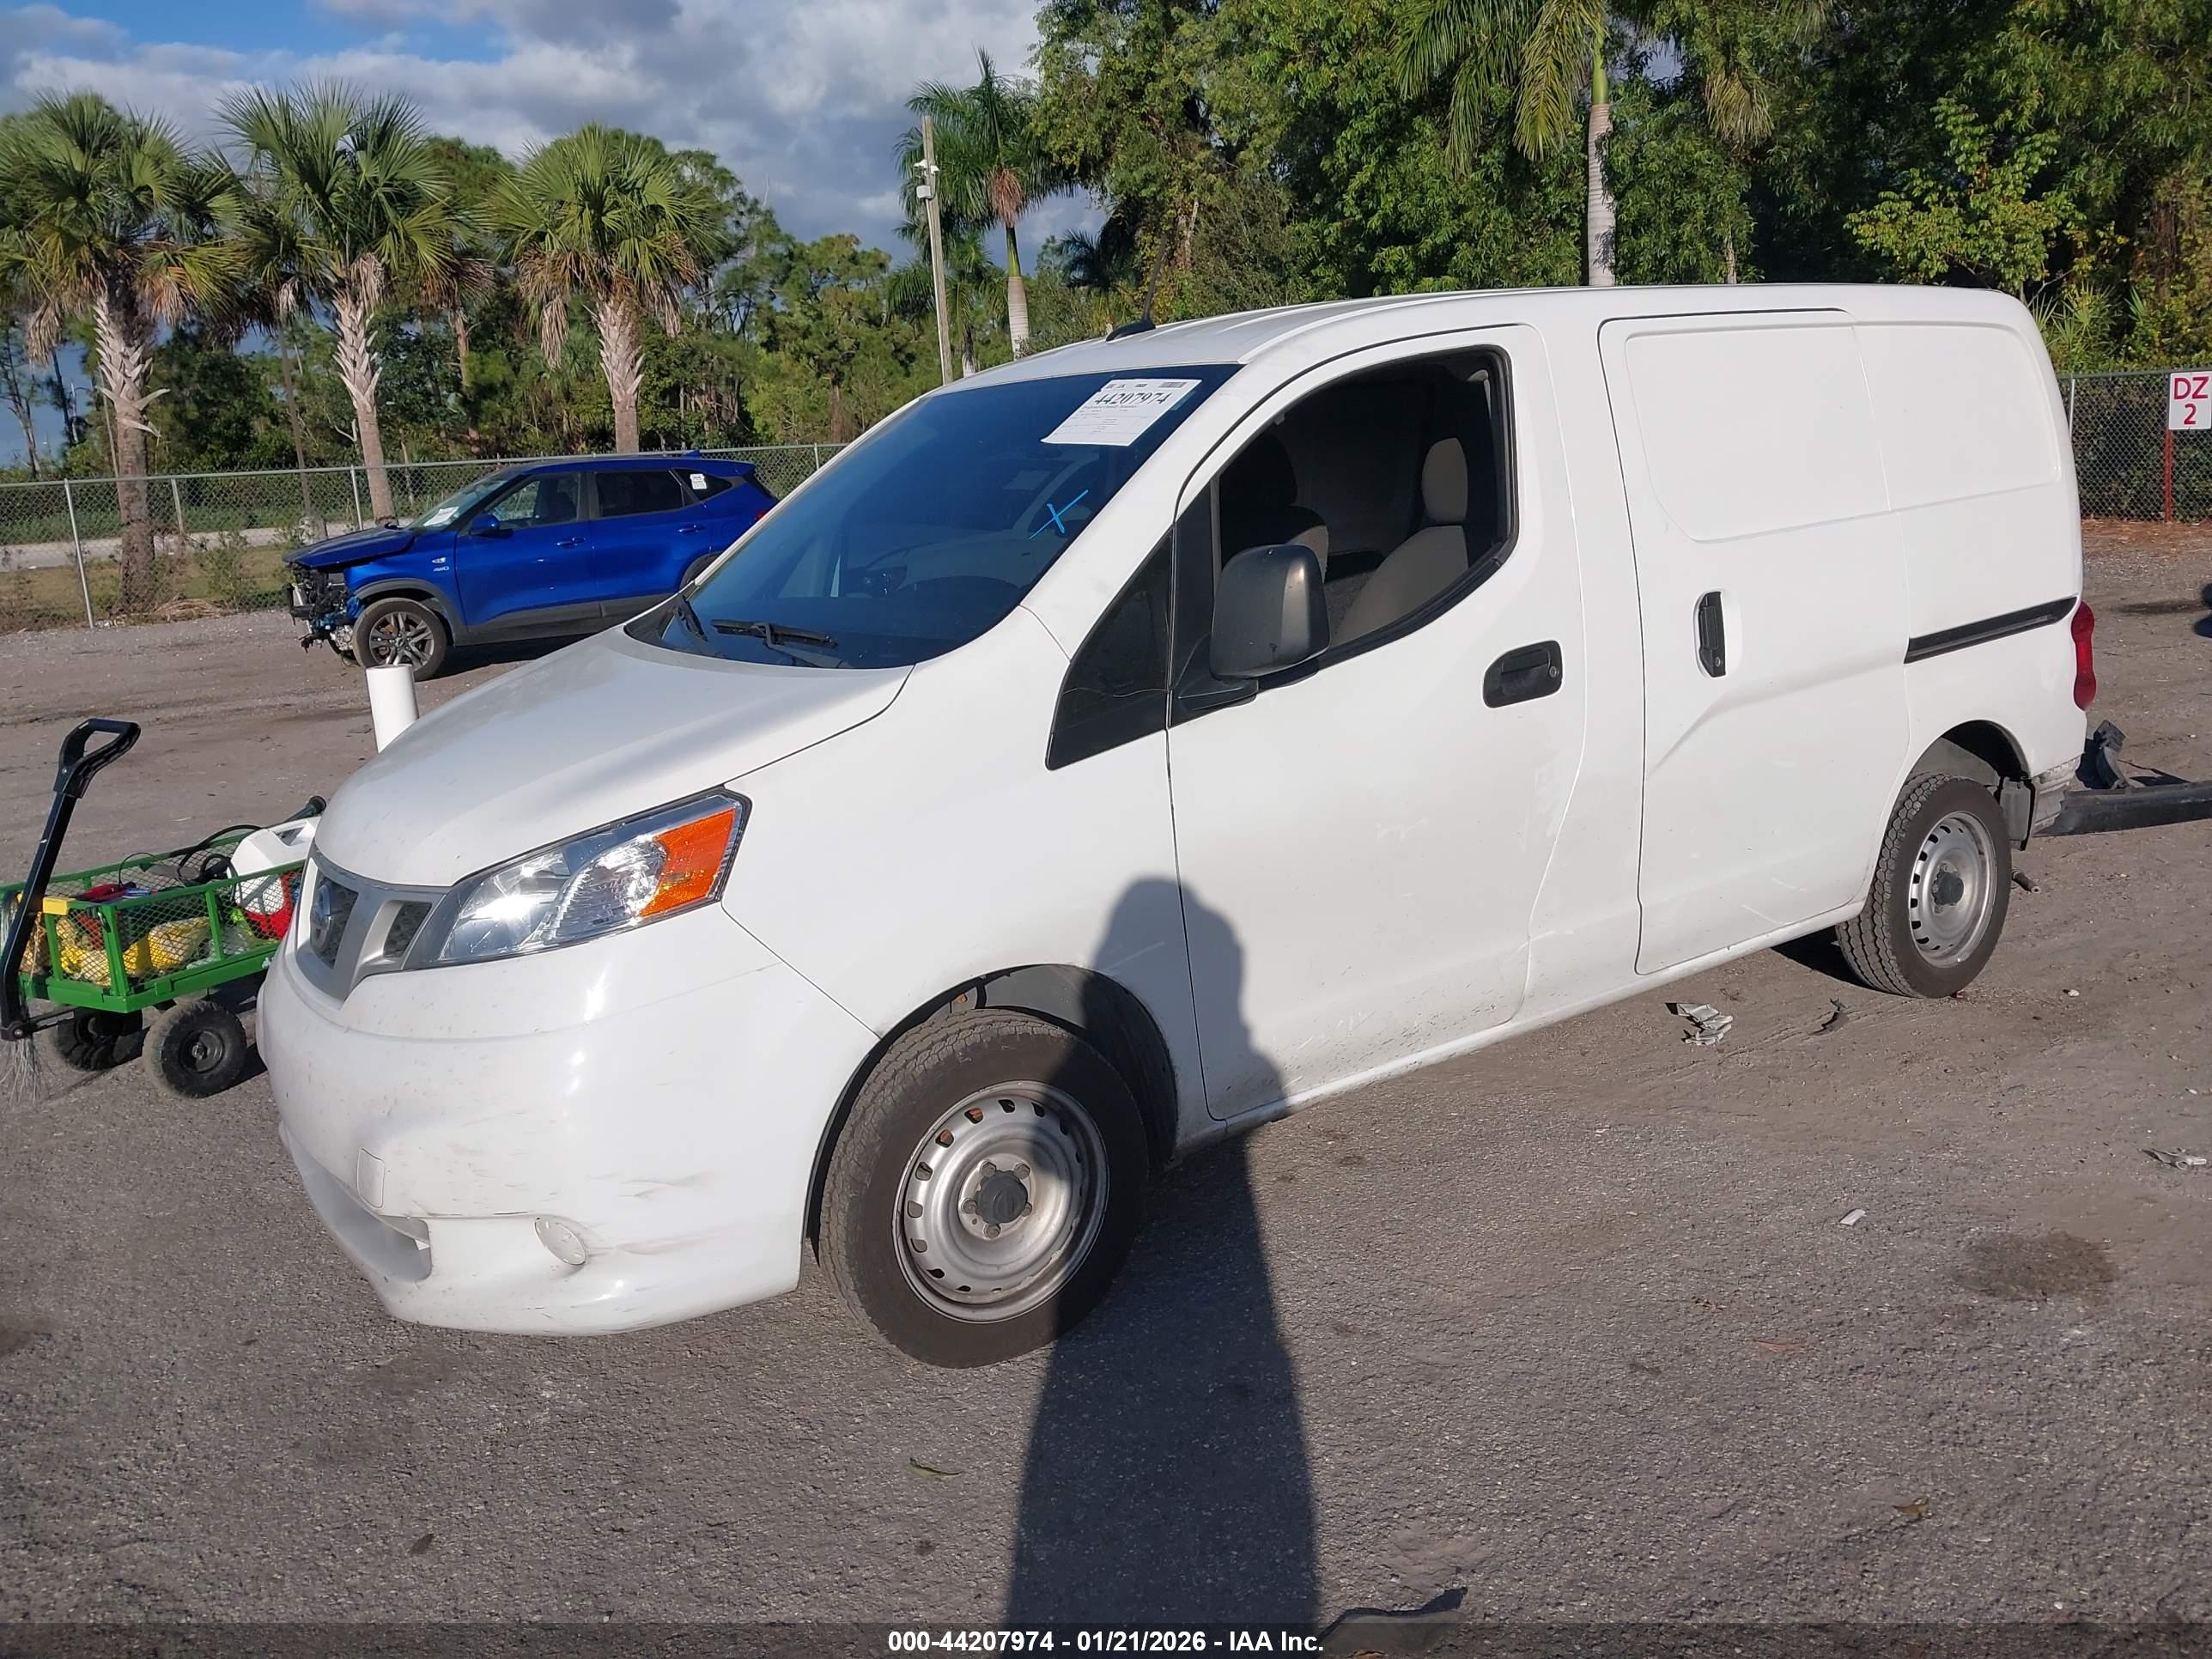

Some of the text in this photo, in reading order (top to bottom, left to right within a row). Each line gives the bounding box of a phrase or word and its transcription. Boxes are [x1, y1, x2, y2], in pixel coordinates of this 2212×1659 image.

[1094, 392, 1173, 405] 44207974
[2173, 376, 2209, 400] DZ
[2184, 403, 2197, 425] 2
